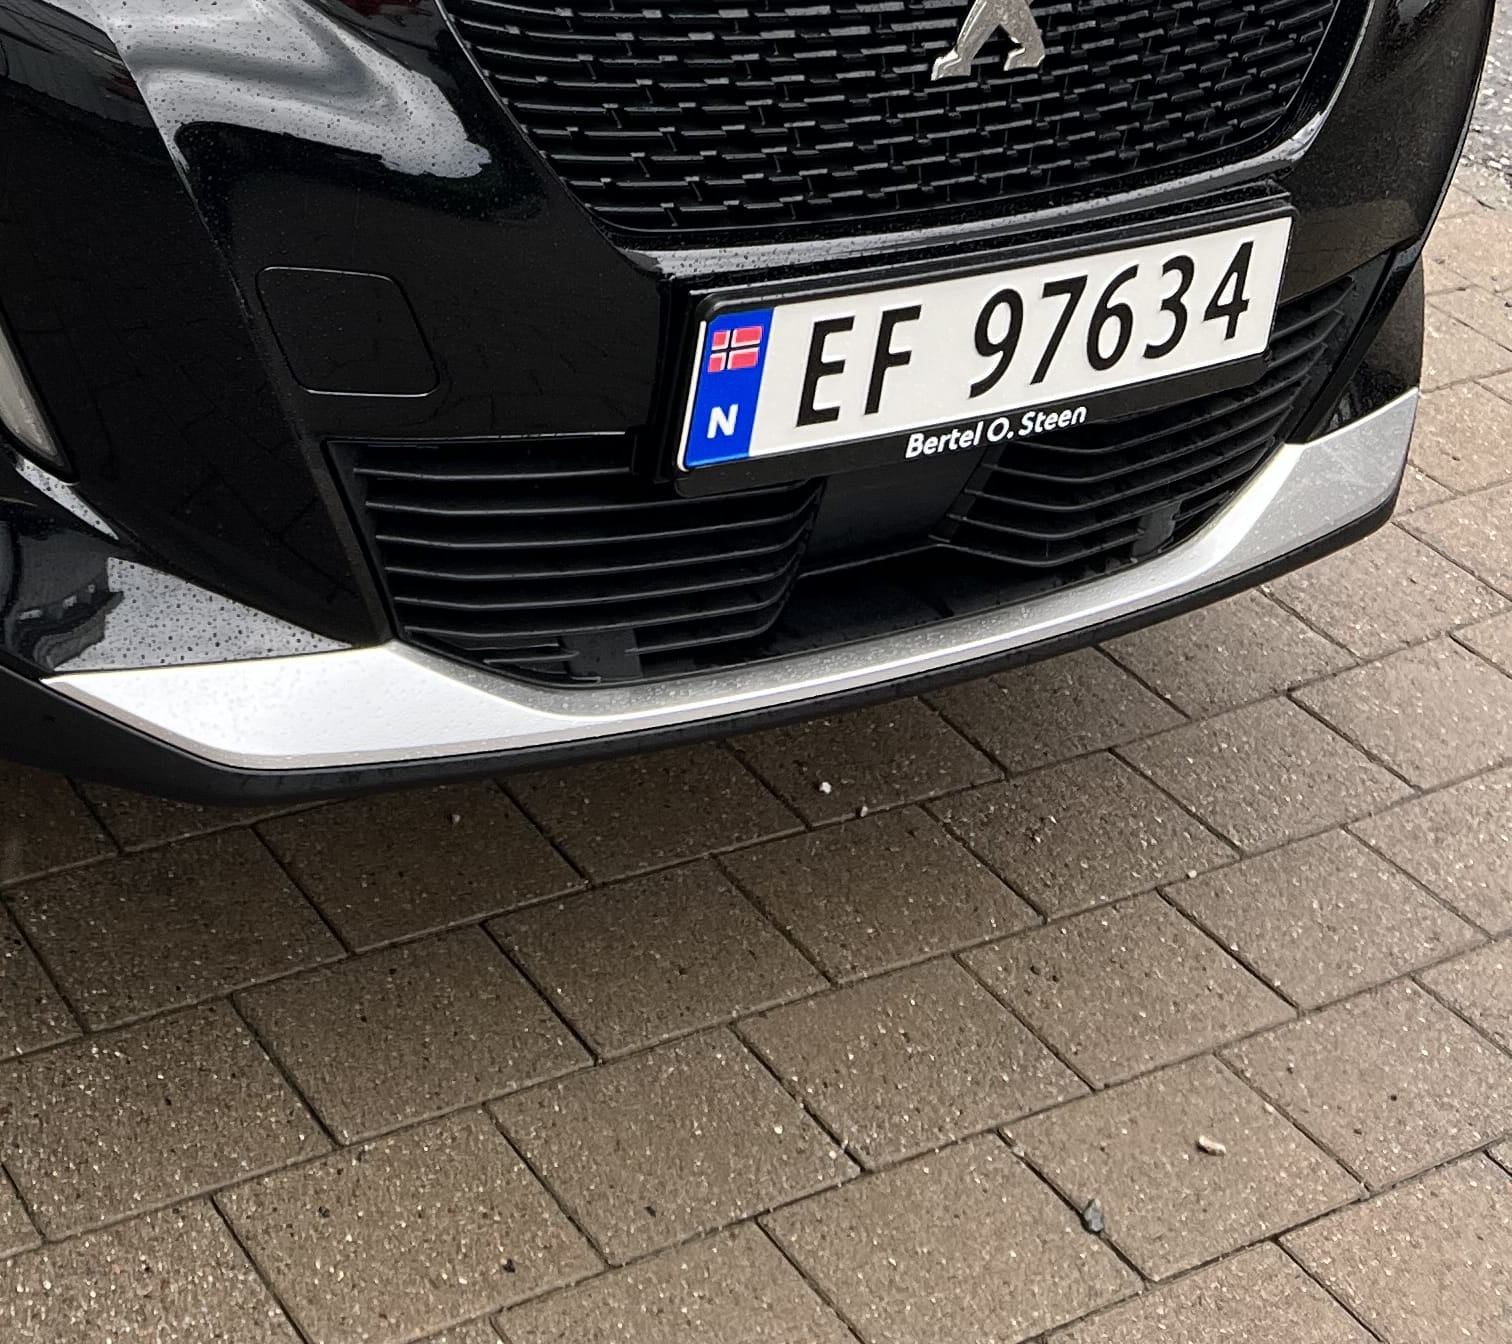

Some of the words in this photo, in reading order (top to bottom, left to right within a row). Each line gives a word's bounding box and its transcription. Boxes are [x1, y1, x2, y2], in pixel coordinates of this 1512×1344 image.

[796, 305, 922, 427] EF
[969, 241, 1254, 400] 97634
[707, 403, 739, 439] N
[905, 421, 984, 459] Bertel
[987, 417, 1015, 443] O.
[1018, 406, 1088, 437] Steen
